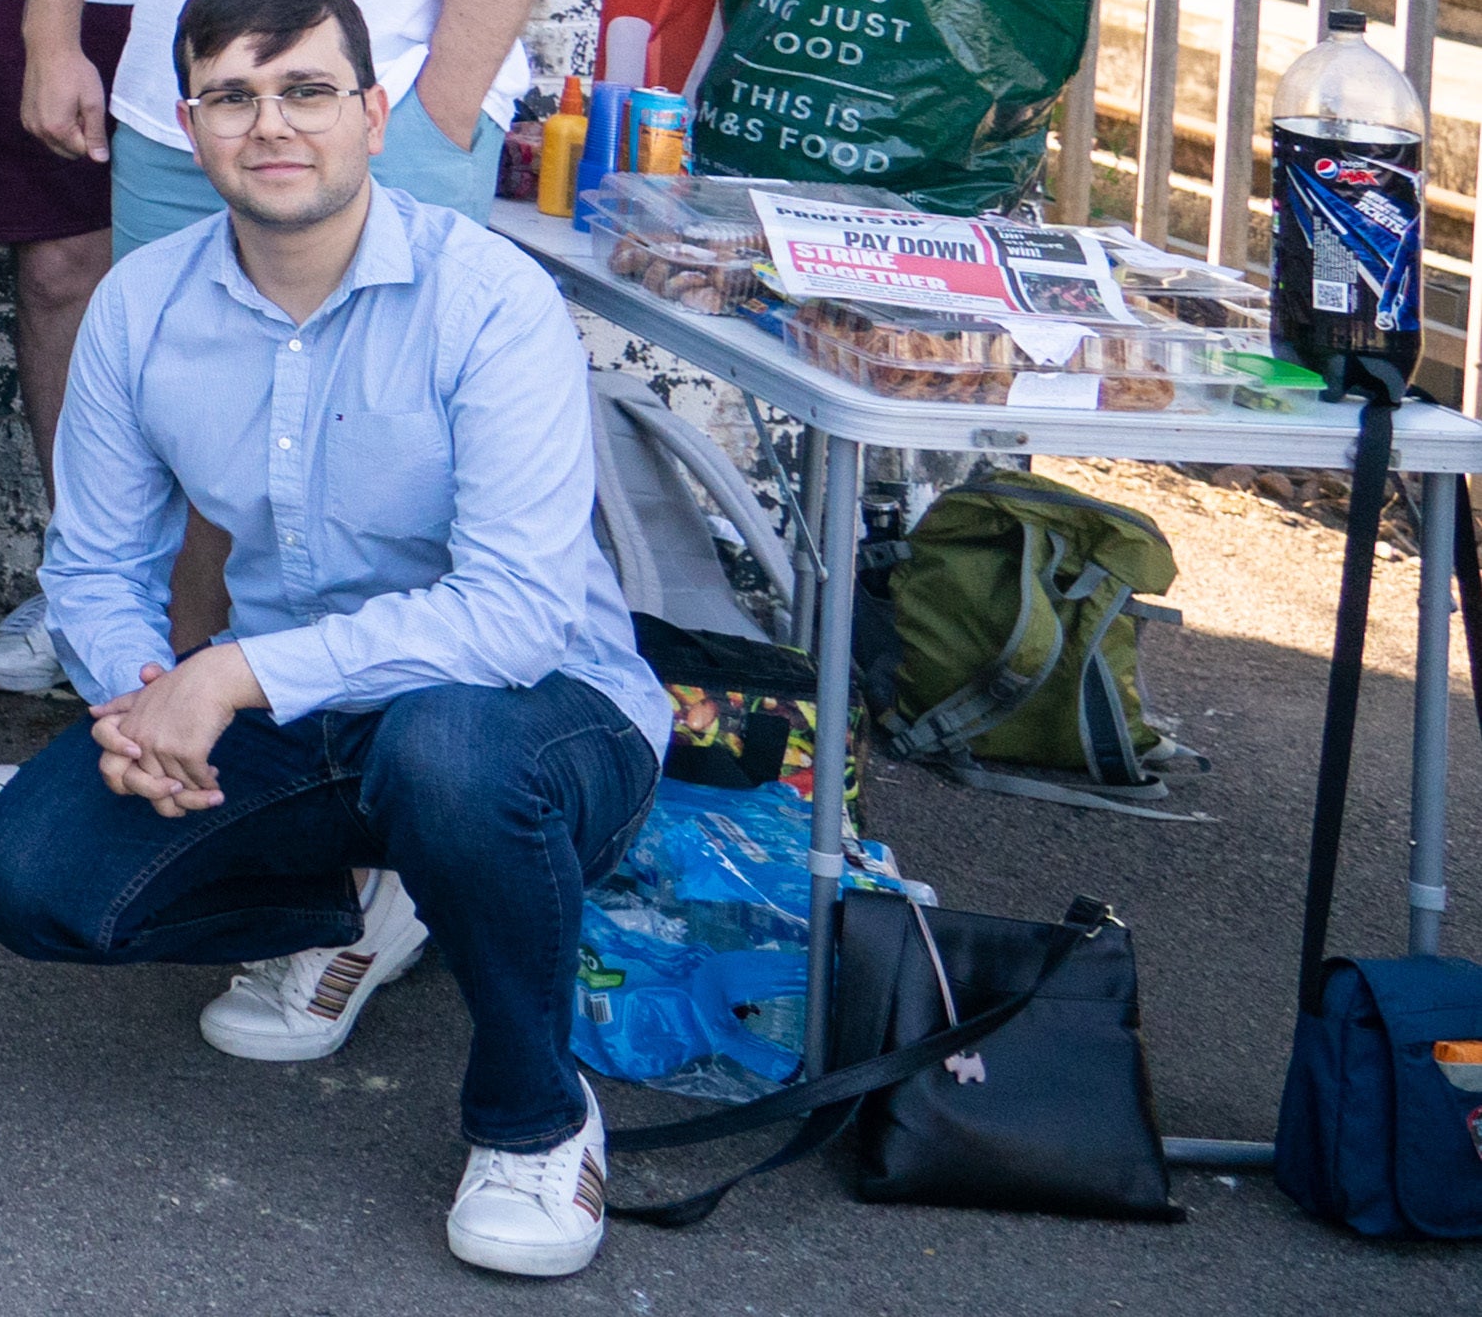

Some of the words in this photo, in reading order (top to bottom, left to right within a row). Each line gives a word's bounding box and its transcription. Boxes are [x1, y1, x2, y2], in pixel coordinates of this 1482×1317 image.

[810, 5, 911, 43] JUST
[731, 79, 813, 120] THIS
[825, 103, 860, 133] IS
[698, 101, 764, 142] M&S
[779, 127, 889, 173] FOOD
[775, 207, 886, 226] PROFITS
[796, 242, 898, 269] STRIKE
[844, 231, 890, 250] PAY
[898, 236, 977, 263] DOWN
[796, 264, 948, 291] TOGETHER
